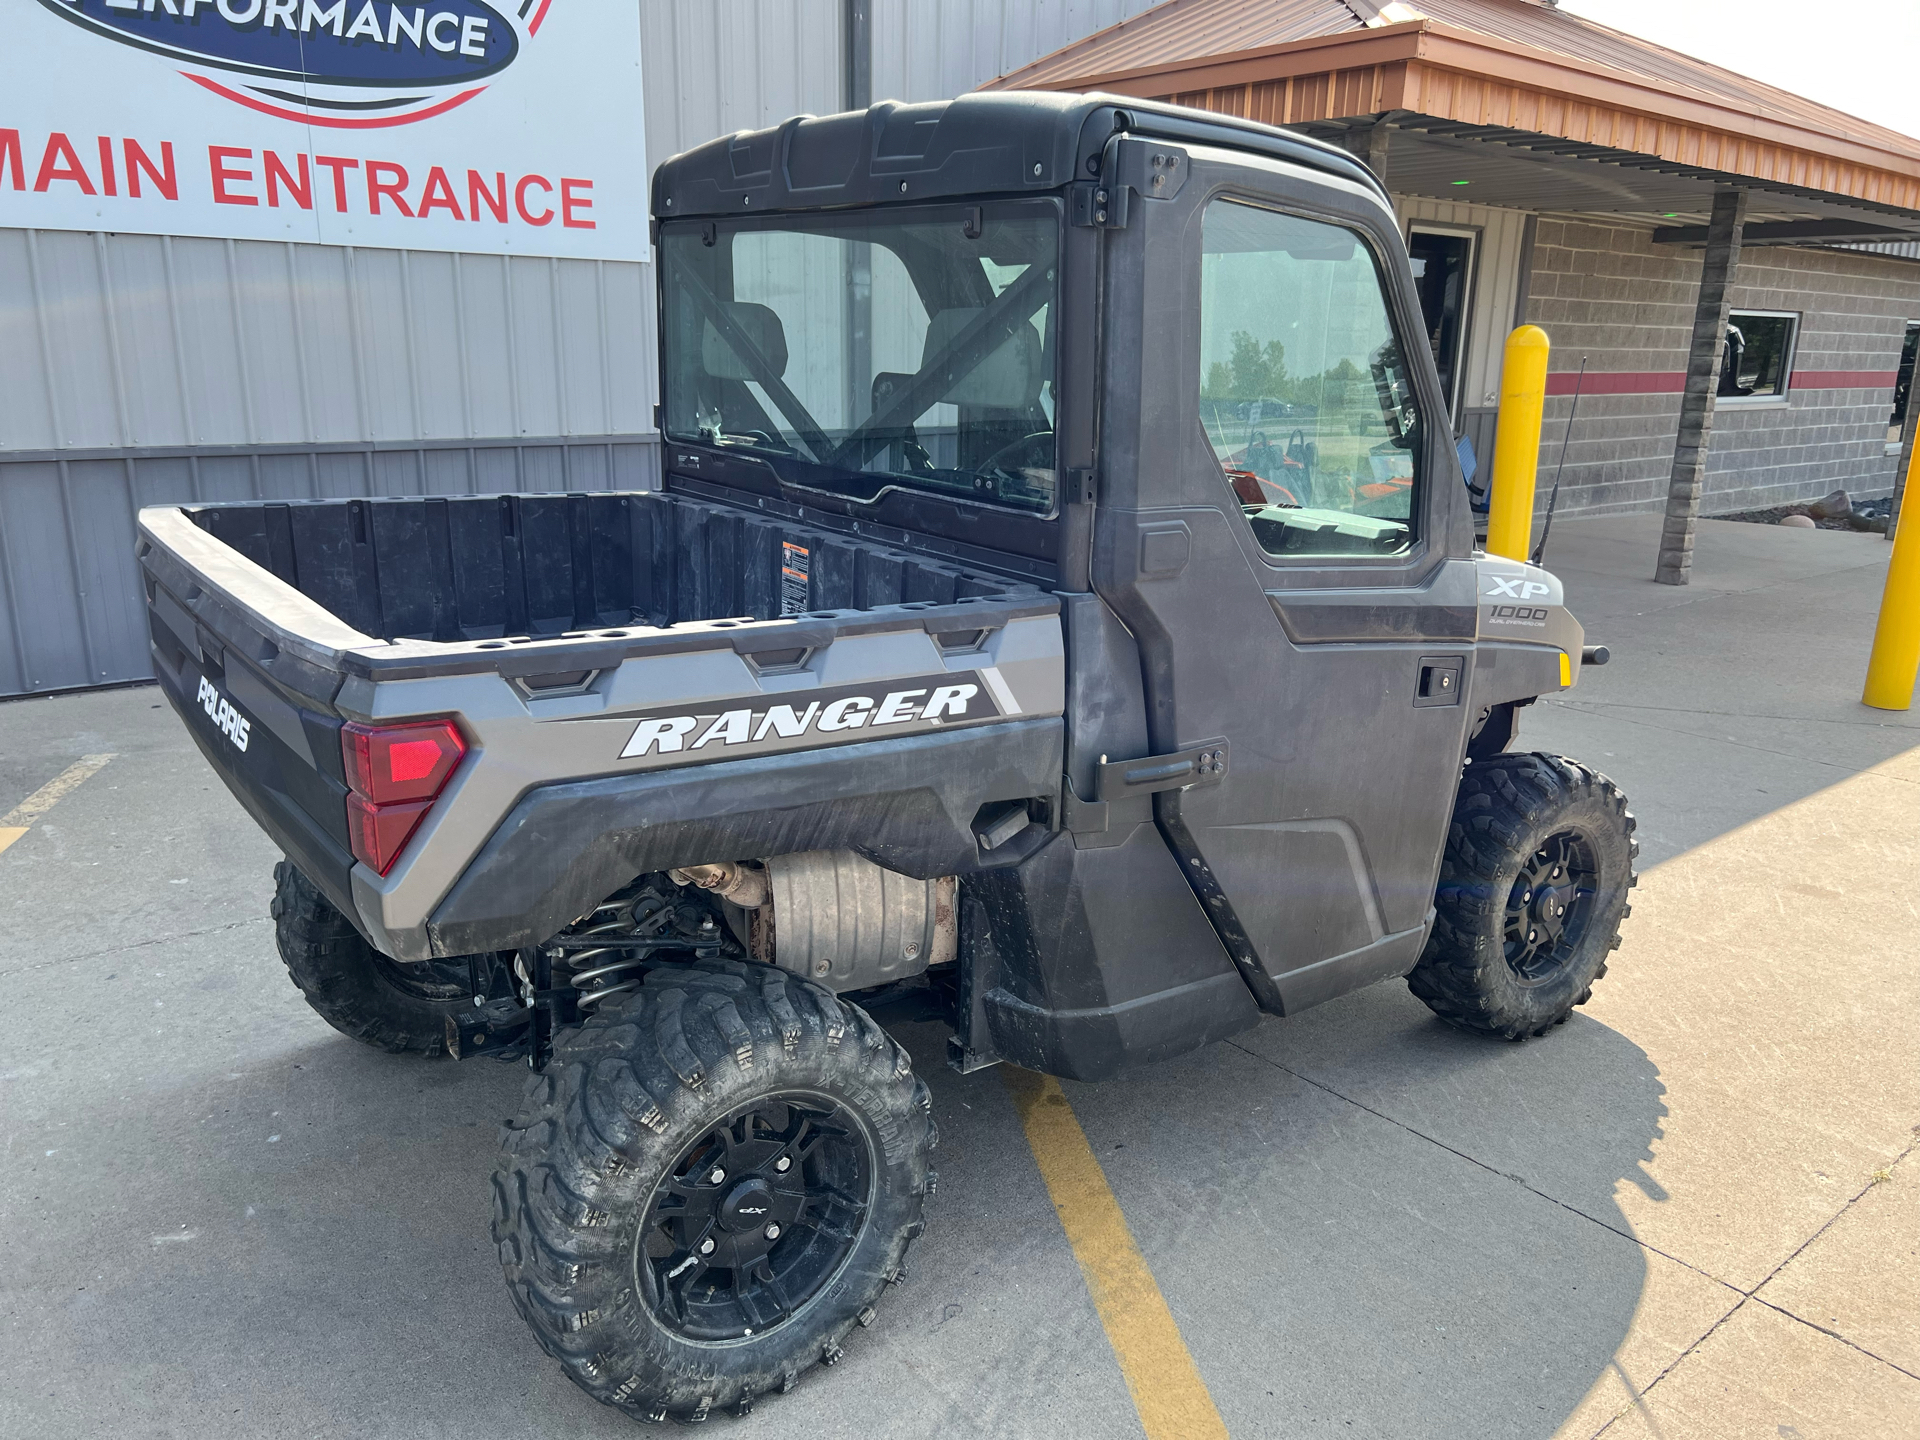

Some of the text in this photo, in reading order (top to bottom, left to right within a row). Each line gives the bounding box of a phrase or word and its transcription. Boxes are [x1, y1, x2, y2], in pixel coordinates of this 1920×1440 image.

[66, 0, 489, 57] ORMANCE
[208, 145, 597, 230] ENTRANCE
[1485, 577, 1549, 599] XP
[1490, 605, 1548, 620] 1000
[197, 675, 251, 753] POLARIS
[617, 684, 979, 760] RANGER
[814, 1072, 905, 1166] X-TERRAIN
